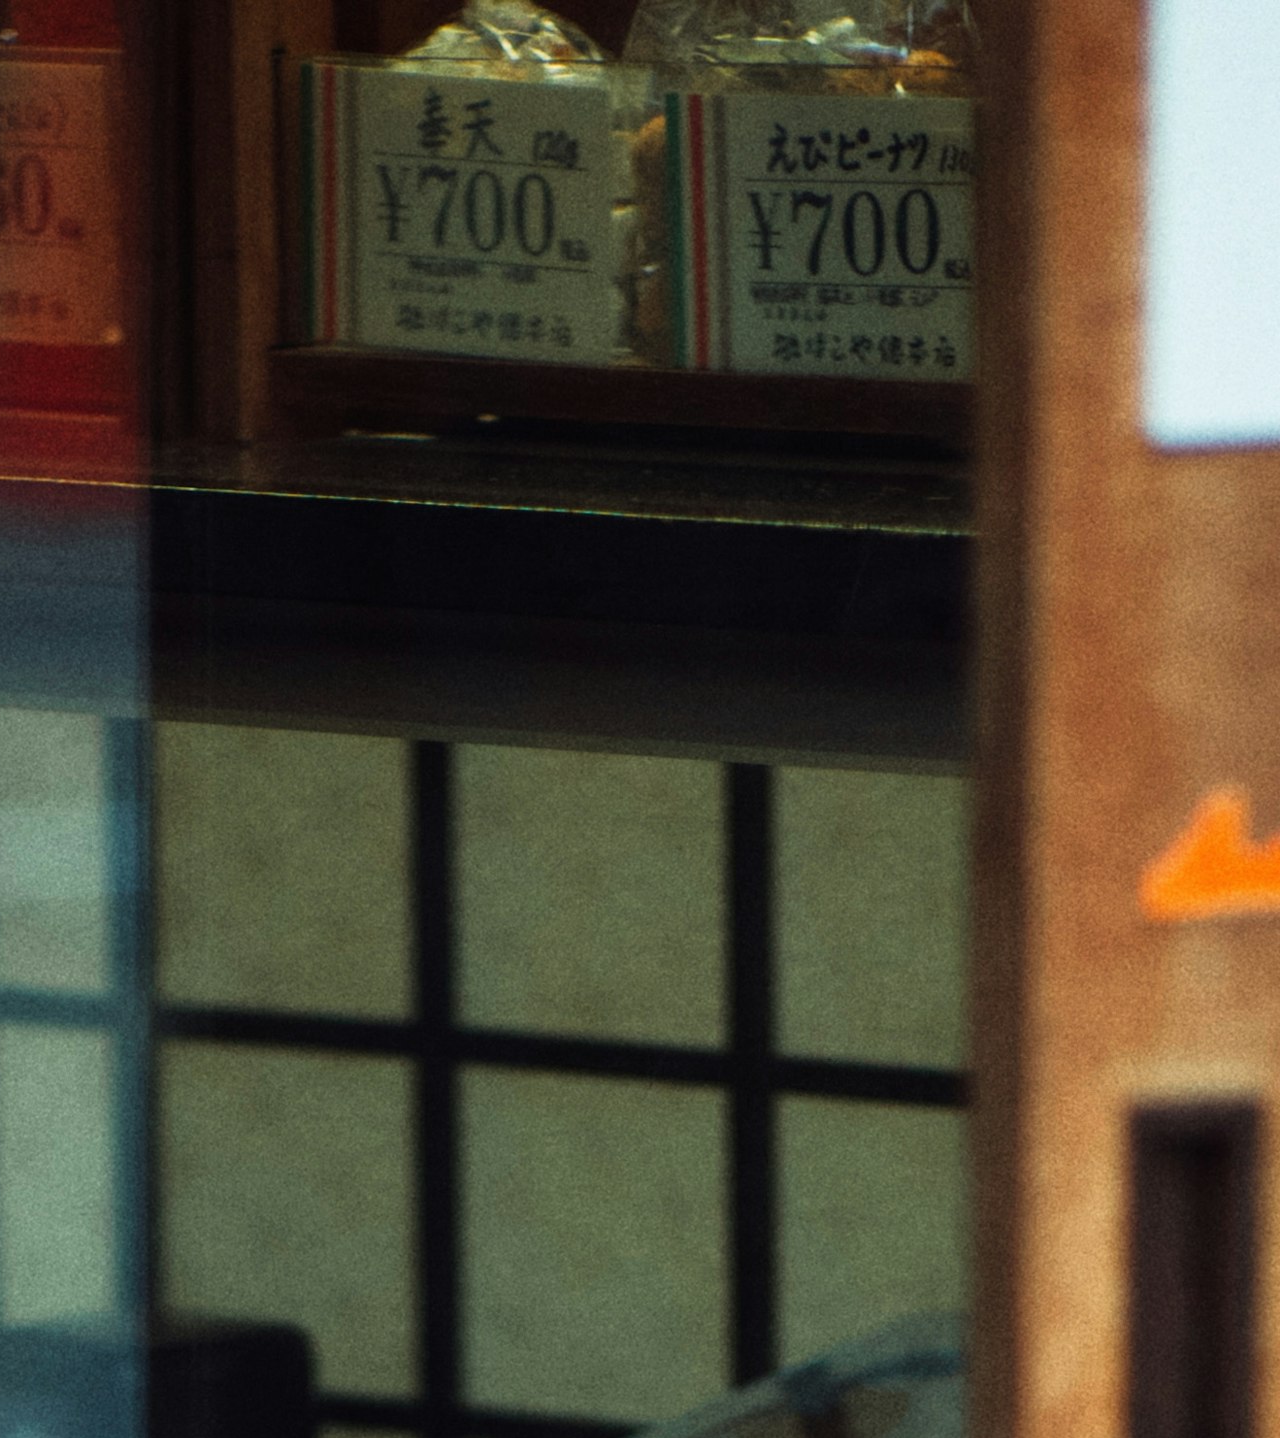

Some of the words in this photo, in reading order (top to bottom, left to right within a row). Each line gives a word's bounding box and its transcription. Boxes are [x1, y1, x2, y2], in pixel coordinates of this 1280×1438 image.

[764, 121, 930, 175] えびピーナツ
[376, 164, 557, 259] ¥700
[746, 188, 941, 278] ¥700
